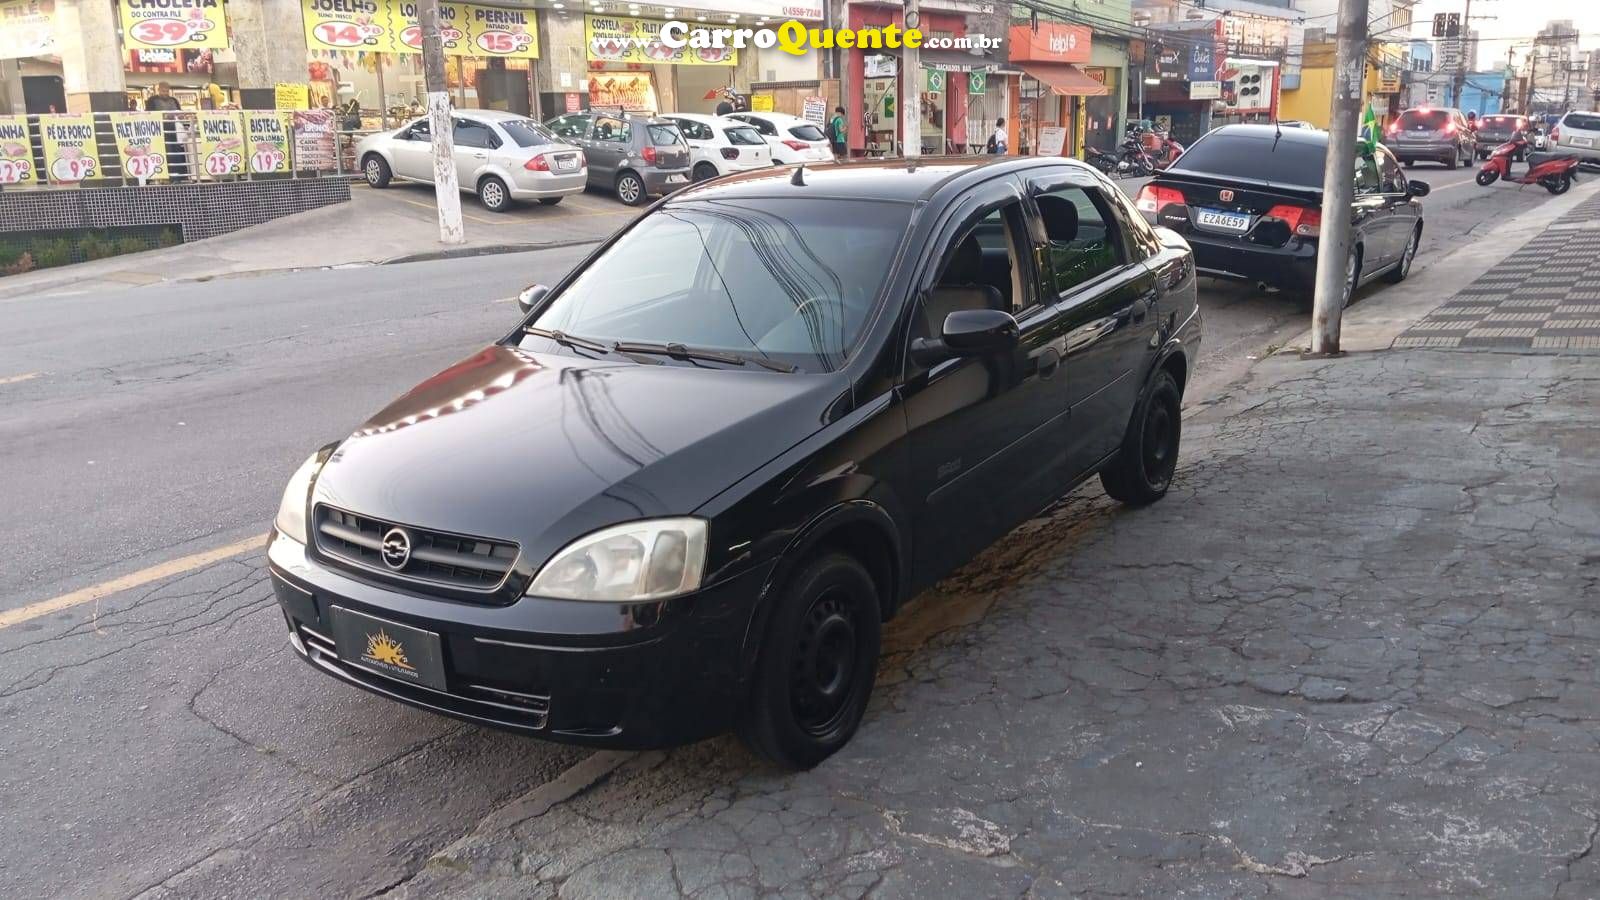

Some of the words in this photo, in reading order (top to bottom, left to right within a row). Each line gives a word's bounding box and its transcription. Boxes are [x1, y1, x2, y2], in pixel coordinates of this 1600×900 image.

[143, 10, 168, 18] CONTRA
[475, 9, 528, 25] PERNIL
[139, 22, 187, 42] 39
[592, 18, 620, 31] COSTELA
[321, 25, 362, 43] 14
[483, 34, 513, 51] 15
[56, 125, 68, 140] DE
[133, 120, 162, 137] MIGNON
[203, 119, 238, 135] PANCETA
[249, 118, 282, 134] BISTECA
[57, 140, 84, 148] FRESCO
[250, 135, 265, 143] COPA
[70, 160, 79, 178] 9
[210, 156, 227, 174] 25
[256, 154, 272, 171] 19
[1203, 213, 1245, 229] EZA6E59
